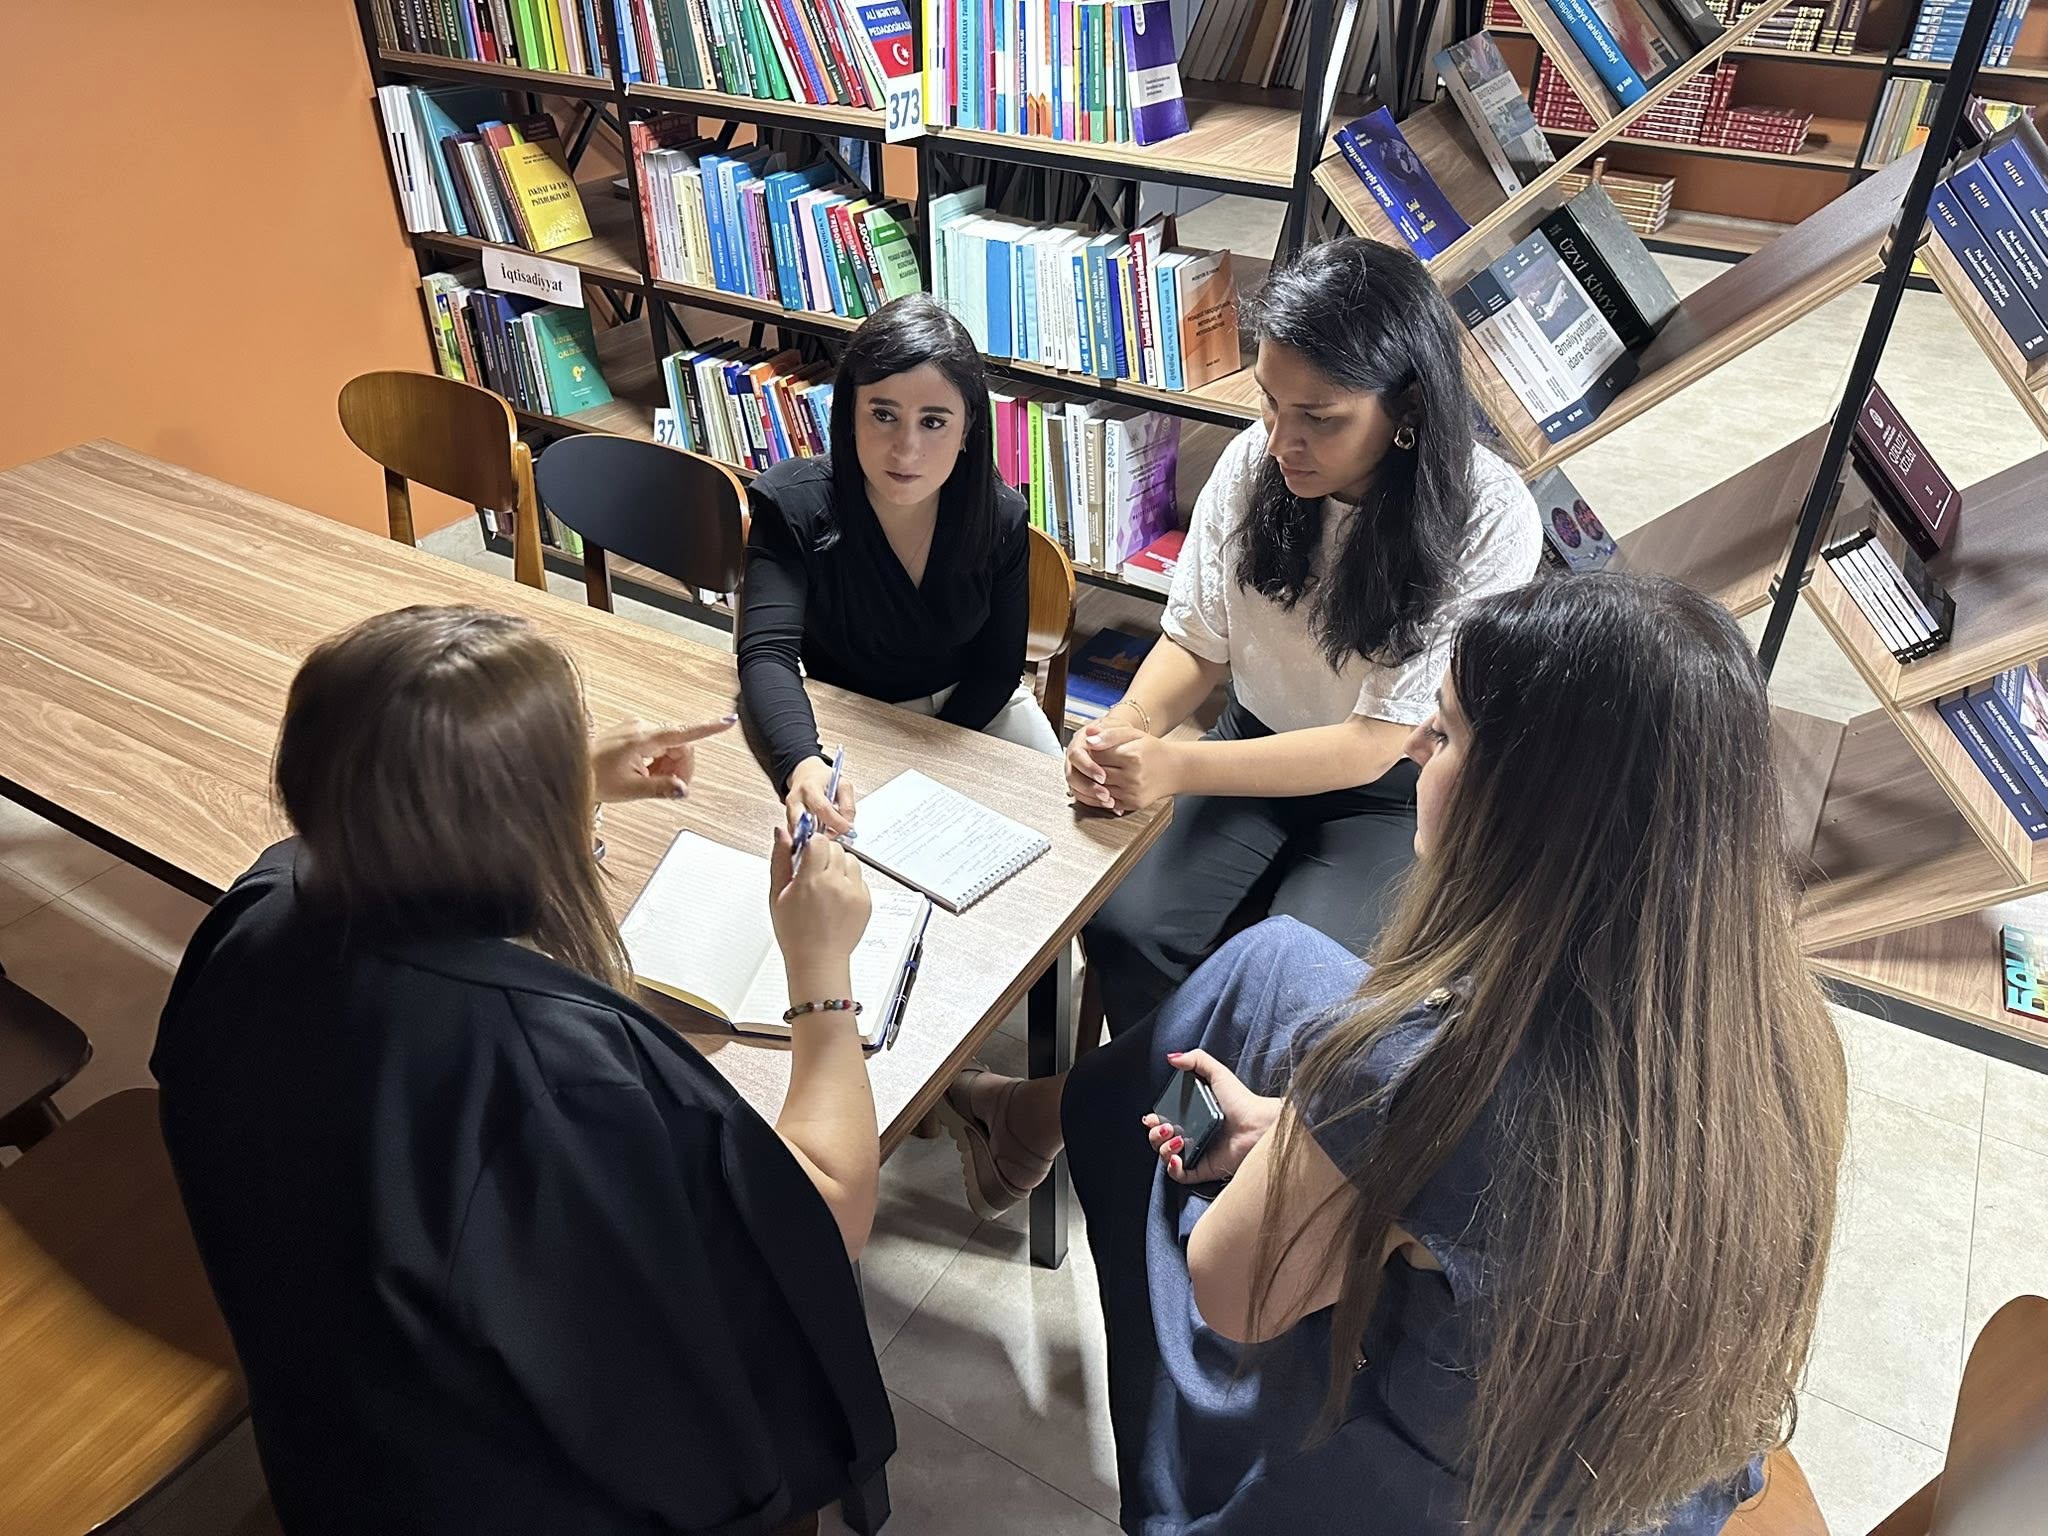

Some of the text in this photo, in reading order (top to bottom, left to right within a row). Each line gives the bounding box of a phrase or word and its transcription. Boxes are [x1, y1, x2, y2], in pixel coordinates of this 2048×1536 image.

[889, 88, 920, 130] 373
[2003, 160, 2024, 187] MİŞKİN
[1936, 202, 1958, 228] MİŞKİN
[1969, 182, 1990, 209] MİŞKİN
[858, 222, 879, 274] PEDAGOGY
[500, 263, 563, 292] İqtisadiyyat
[1556, 236, 1622, 320] ÜZVİ KİMYA
[1554, 313, 1599, 357] Əməliyyatların
[1087, 442, 1095, 502] MATERİALLARI
